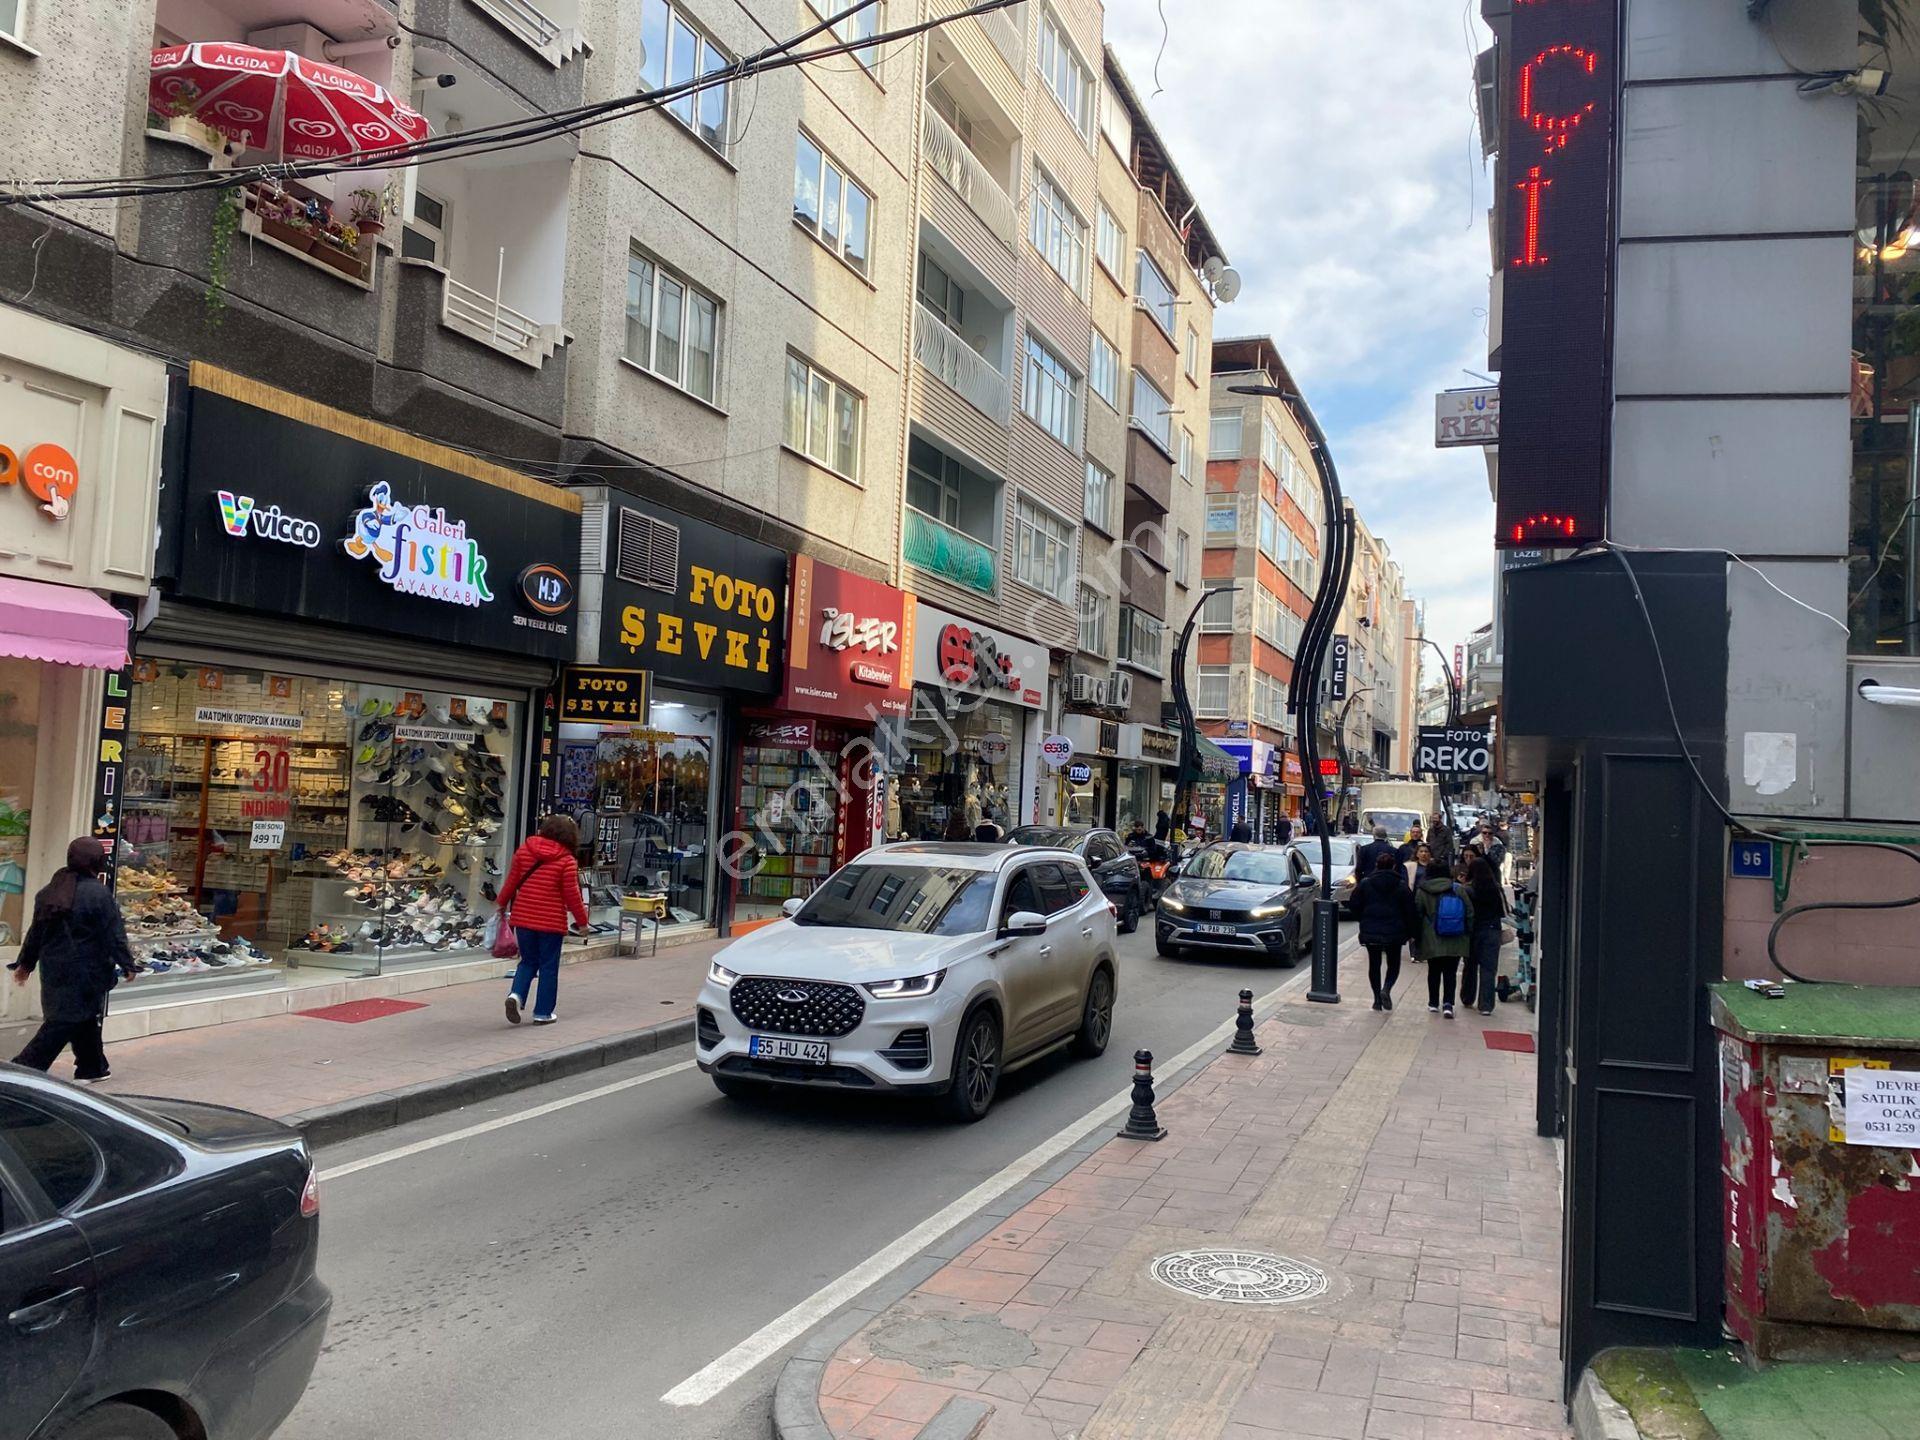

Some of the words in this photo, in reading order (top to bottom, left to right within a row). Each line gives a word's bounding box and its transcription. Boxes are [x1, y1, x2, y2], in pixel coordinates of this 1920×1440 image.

[33, 462, 74, 485] com
[414, 508, 466, 541] Galeri
[396, 578, 480, 606] AYAKKABI
[689, 565, 776, 623] FOTO
[620, 604, 771, 674] ŞEVKİ
[1334, 644, 1346, 696] OTEL
[578, 678, 628, 692] FOTO
[566, 699, 637, 714] ŞEVKİ
[1446, 731, 1481, 742] FOTO
[1420, 746, 1489, 771] REKO
[253, 834, 270, 844] 499
[272, 834, 281, 844] TL
[1742, 850, 1761, 866] 96
[758, 1041, 774, 1054] 55
[779, 1042, 798, 1056] HU
[803, 1044, 826, 1060] 424
[1861, 1093, 1917, 1105] SATILIK
[1865, 1122, 1891, 1132] 0531
[1895, 1123, 1915, 1133] 259
